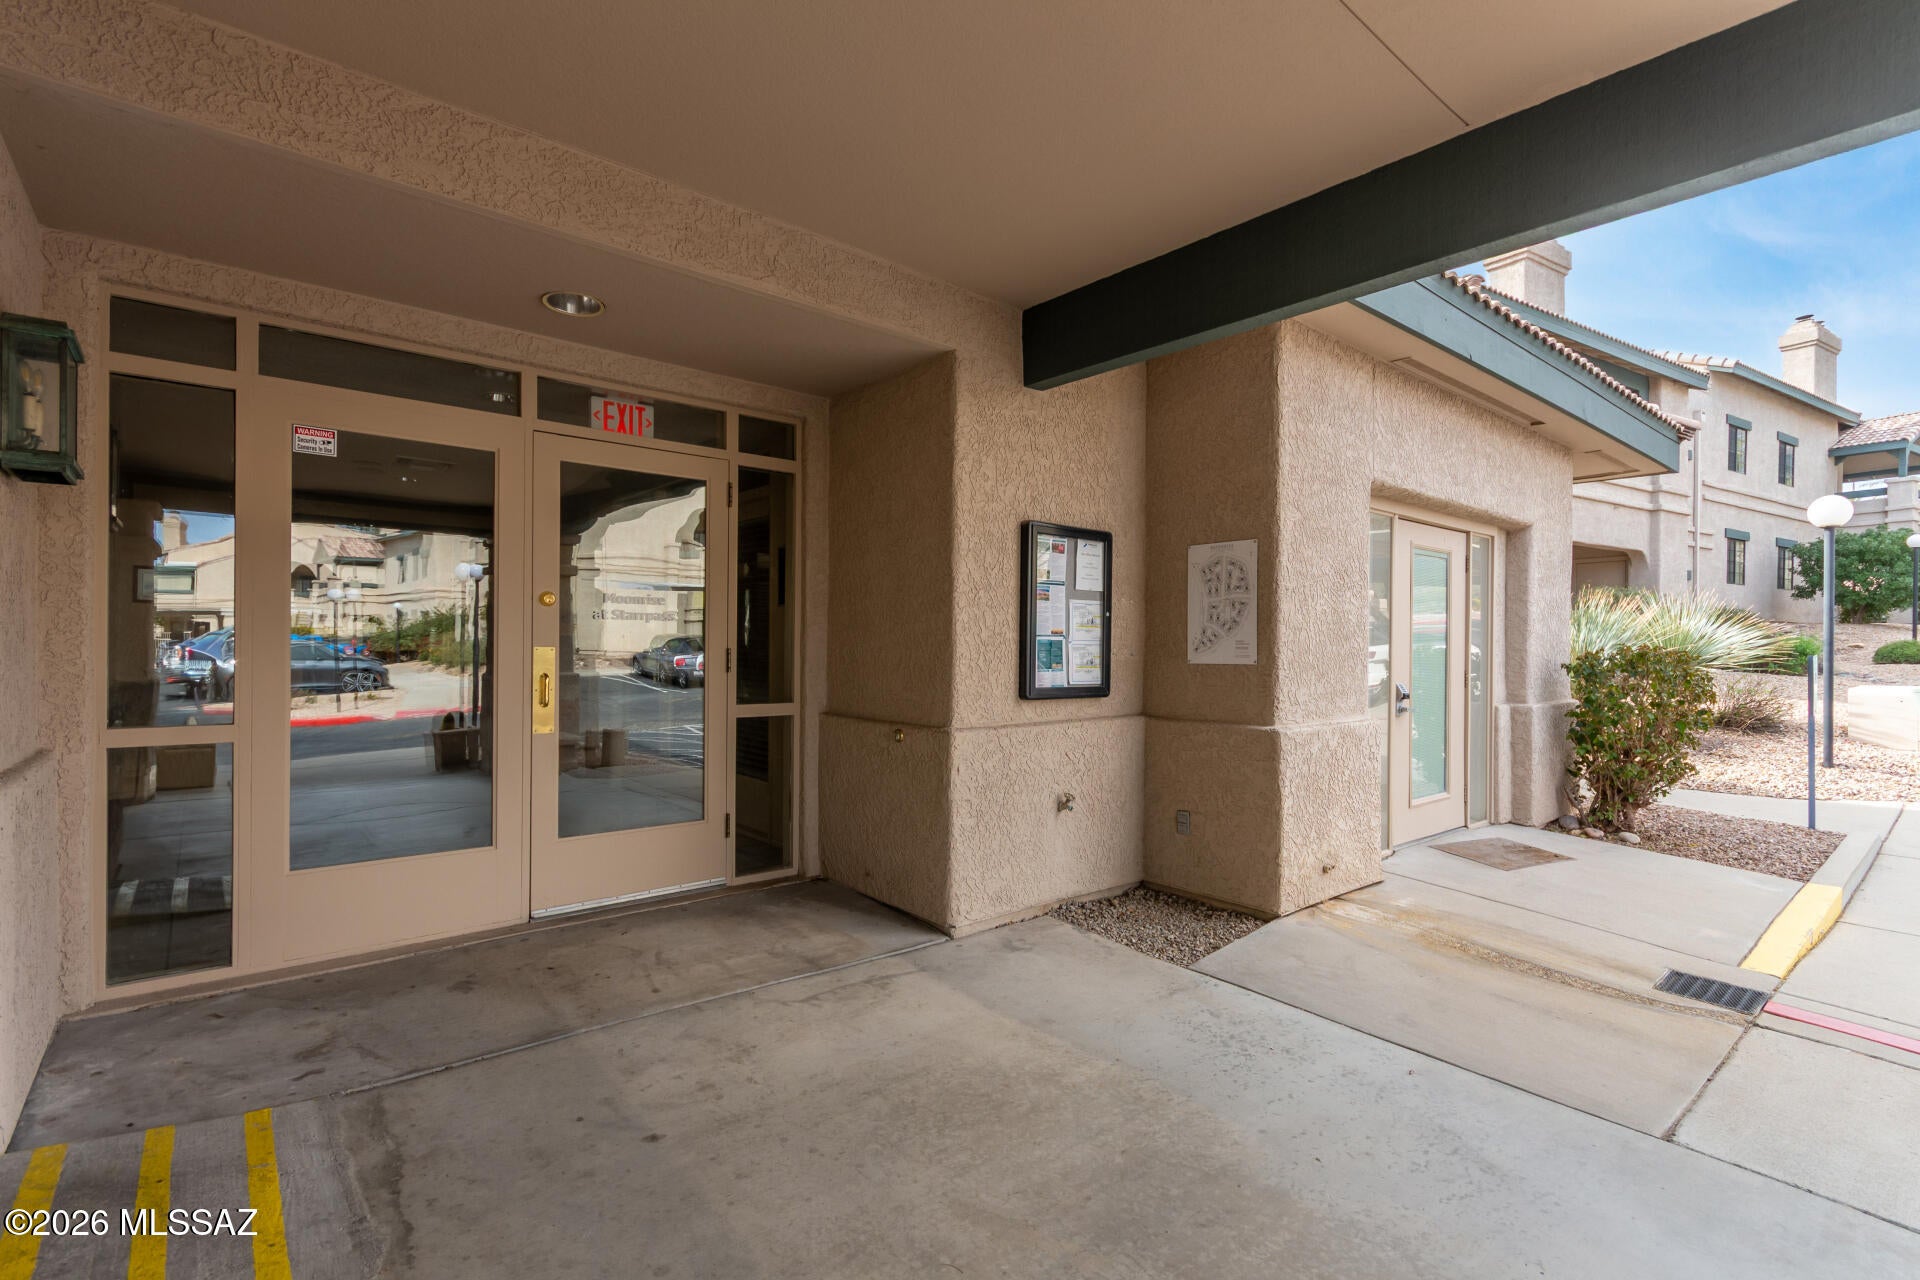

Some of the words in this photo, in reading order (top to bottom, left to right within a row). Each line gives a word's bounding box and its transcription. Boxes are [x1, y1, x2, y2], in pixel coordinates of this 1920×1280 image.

[602, 400, 646, 437] EXIT
[297, 428, 334, 438] WARNING
[297, 436, 318, 446] Security
[297, 443, 317, 452] Cameras
[602, 593, 665, 606] Moonrise
[592, 609, 608, 620] at
